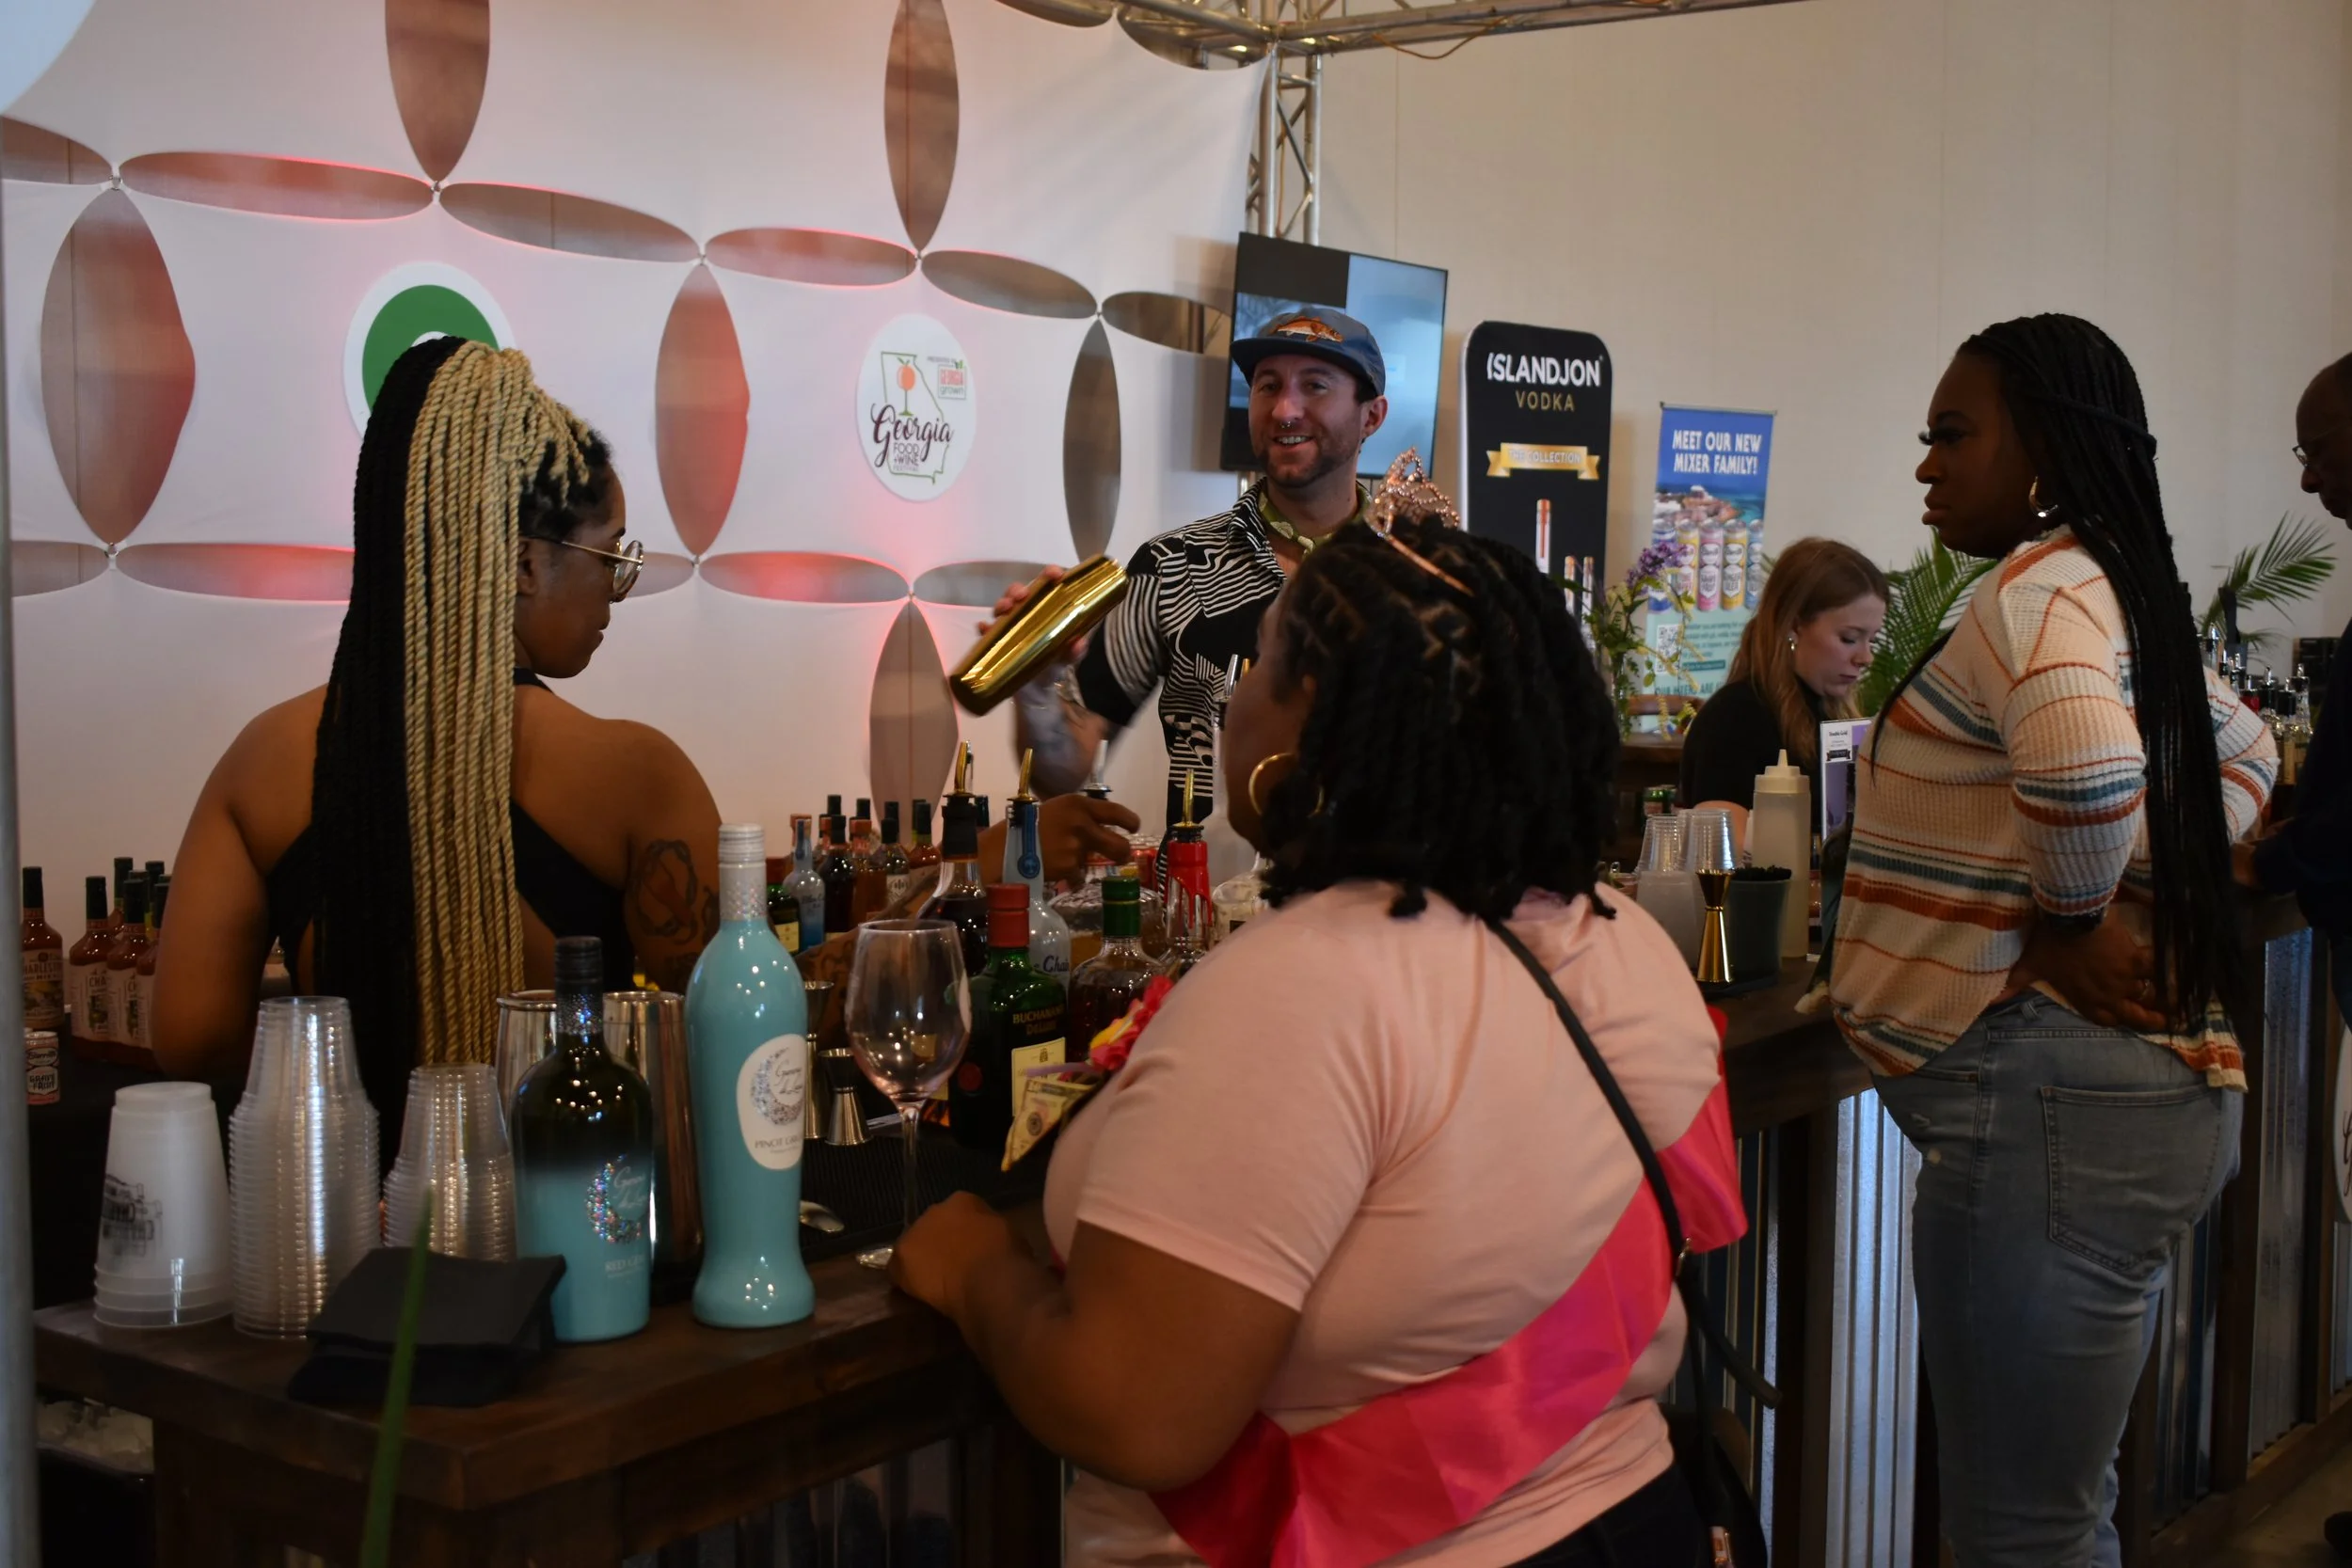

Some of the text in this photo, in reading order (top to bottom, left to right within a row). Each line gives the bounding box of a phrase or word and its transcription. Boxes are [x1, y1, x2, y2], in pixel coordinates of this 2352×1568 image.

[1516, 389, 1575, 413] VODKA
[870, 402, 955, 468] Georgia
[1672, 429, 1762, 453] MEET OUR NEW
[894, 442, 919, 455] FOOD
[1509, 449, 1581, 464] THE COLLECTION
[1673, 452, 1758, 476] MIXER FAMILY!
[1042, 955, 1070, 973] Chai
